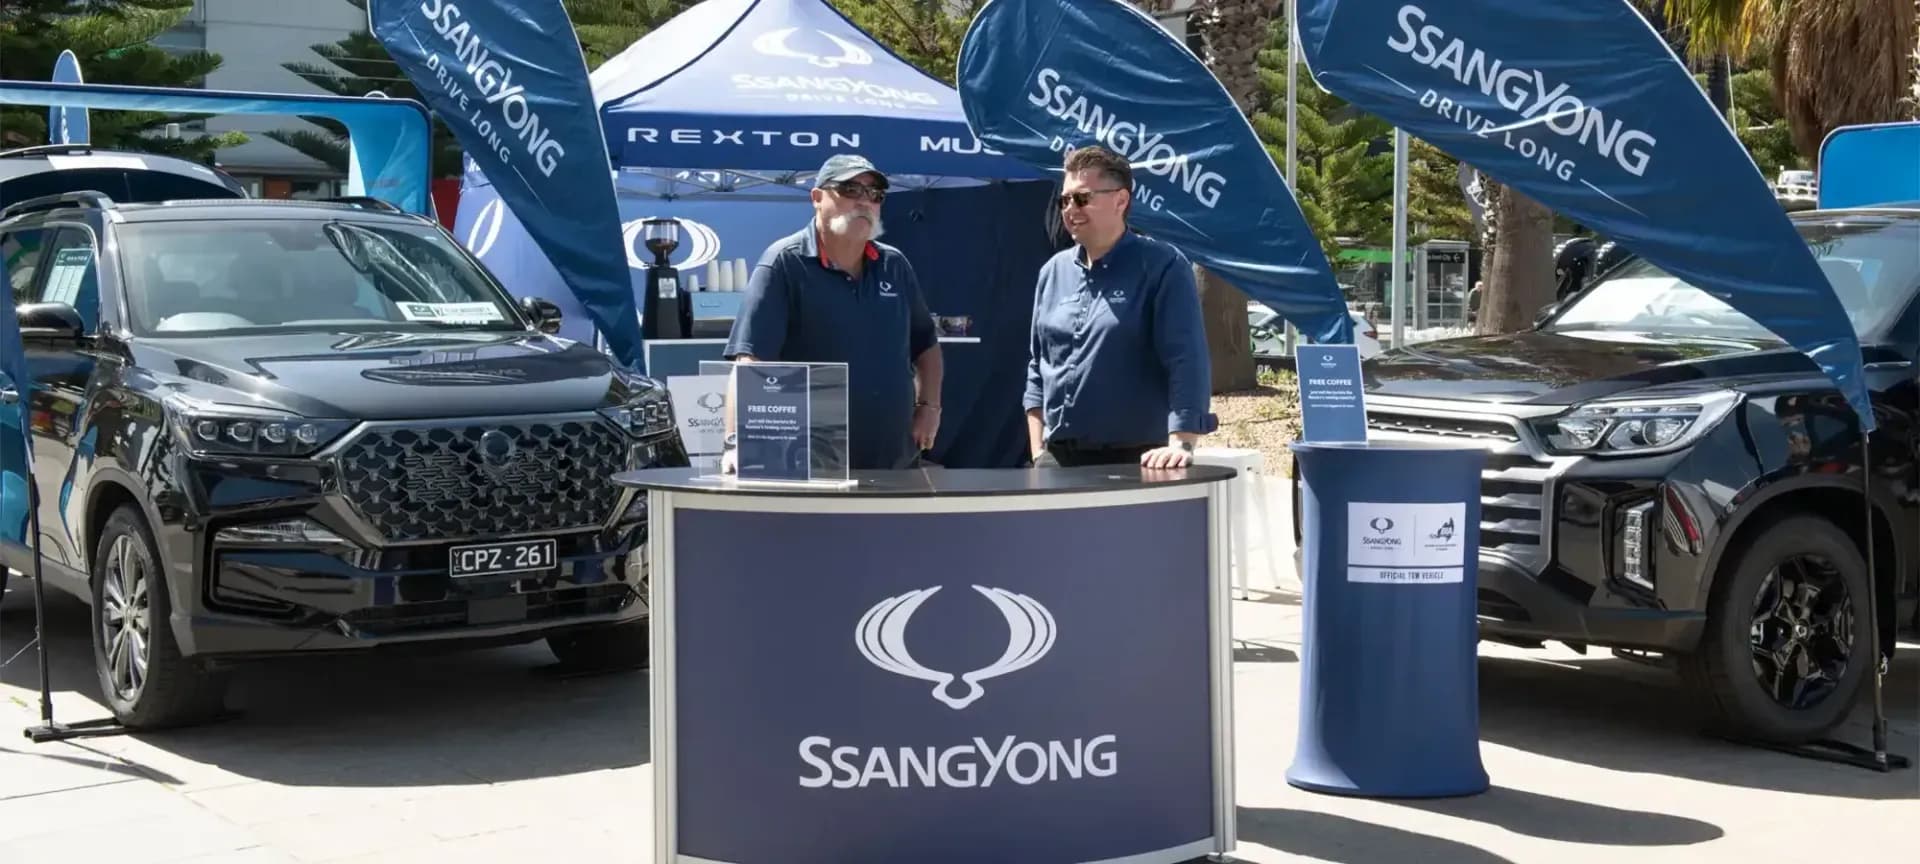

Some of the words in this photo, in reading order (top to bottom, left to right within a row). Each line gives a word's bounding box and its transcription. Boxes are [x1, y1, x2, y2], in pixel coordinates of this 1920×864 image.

[427, 54, 470, 111] DRIVE
[470, 110, 511, 164] LONG
[731, 74, 939, 104] SSANGYONG
[1387, 5, 1656, 177] SSANGYONG
[627, 128, 860, 148] REXTON
[1028, 68, 1227, 208] SSANGYONG
[1419, 89, 1496, 138] DRIVE
[1504, 131, 1576, 181] LONG
[767, 405, 797, 413] COFFEE
[1380, 572, 1406, 580] OFFICIAL
[1408, 572, 1420, 580] TOW
[1422, 572, 1444, 580] VEHICLE
[798, 734, 1118, 789] SSANGYONG
